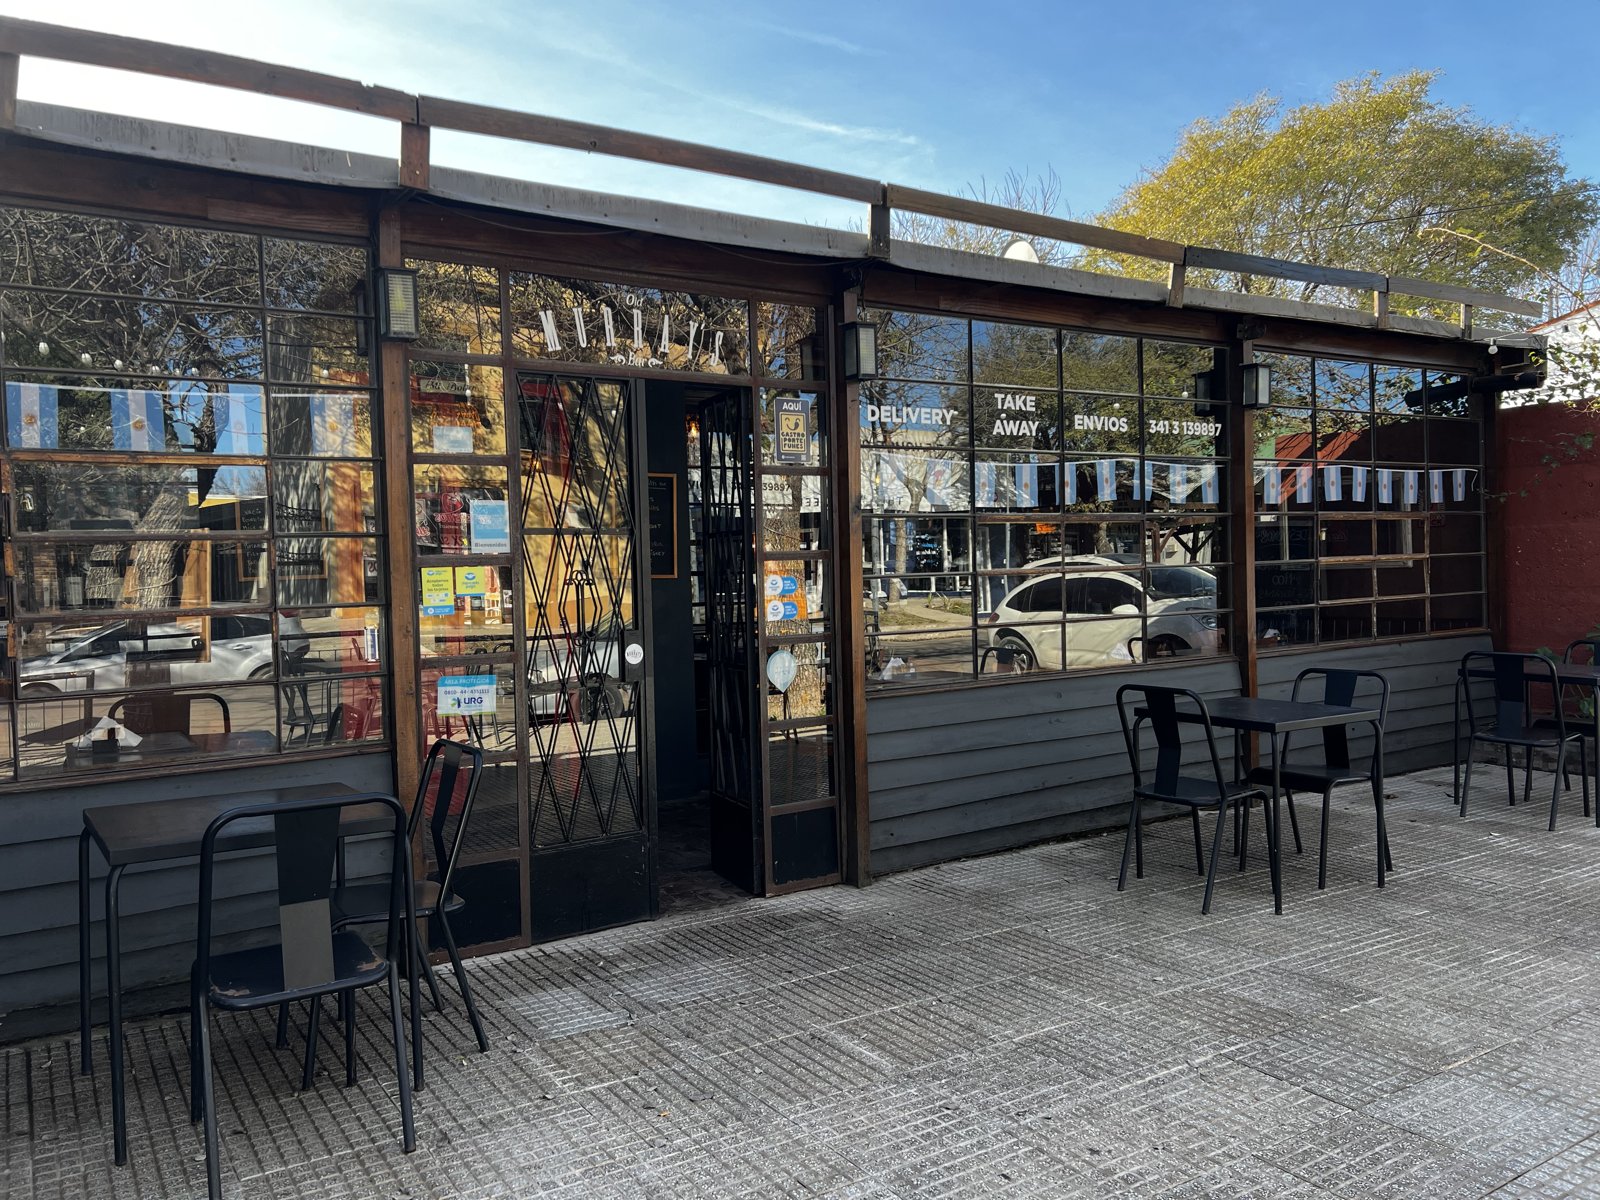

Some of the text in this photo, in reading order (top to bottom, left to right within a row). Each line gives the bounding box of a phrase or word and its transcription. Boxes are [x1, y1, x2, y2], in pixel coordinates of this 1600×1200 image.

[626, 293, 643, 307] Old
[628, 350, 648, 367] Bar
[994, 393, 1036, 411] TAKE
[867, 404, 954, 425] DELIVERY
[992, 419, 1040, 437] AWAY
[1074, 415, 1128, 432] ENVIOS
[1149, 420, 1222, 436] 341 3 139897
